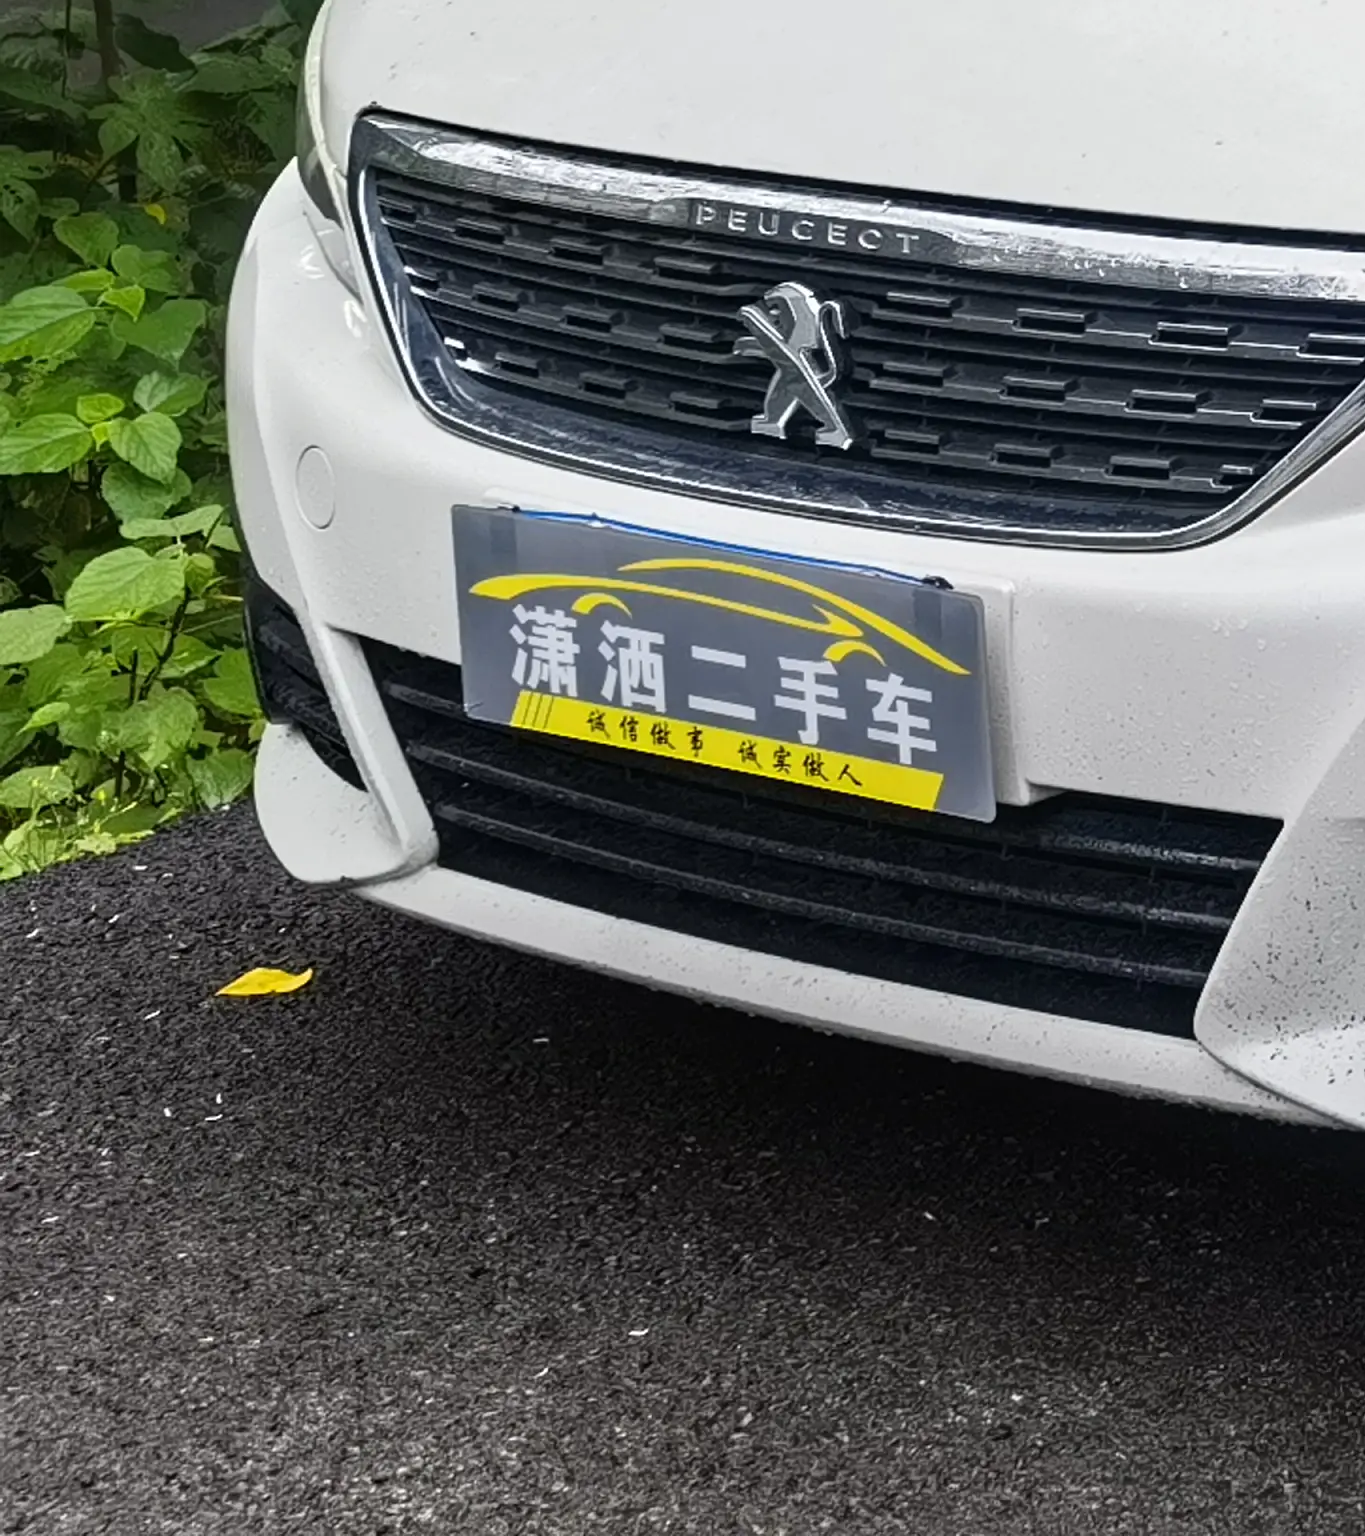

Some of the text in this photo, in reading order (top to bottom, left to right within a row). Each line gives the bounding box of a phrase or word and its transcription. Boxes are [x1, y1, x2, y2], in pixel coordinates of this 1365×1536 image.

[509, 603, 938, 765] 潇洒二手车
[585, 708, 863, 787] 诚信做事 诚实做人
